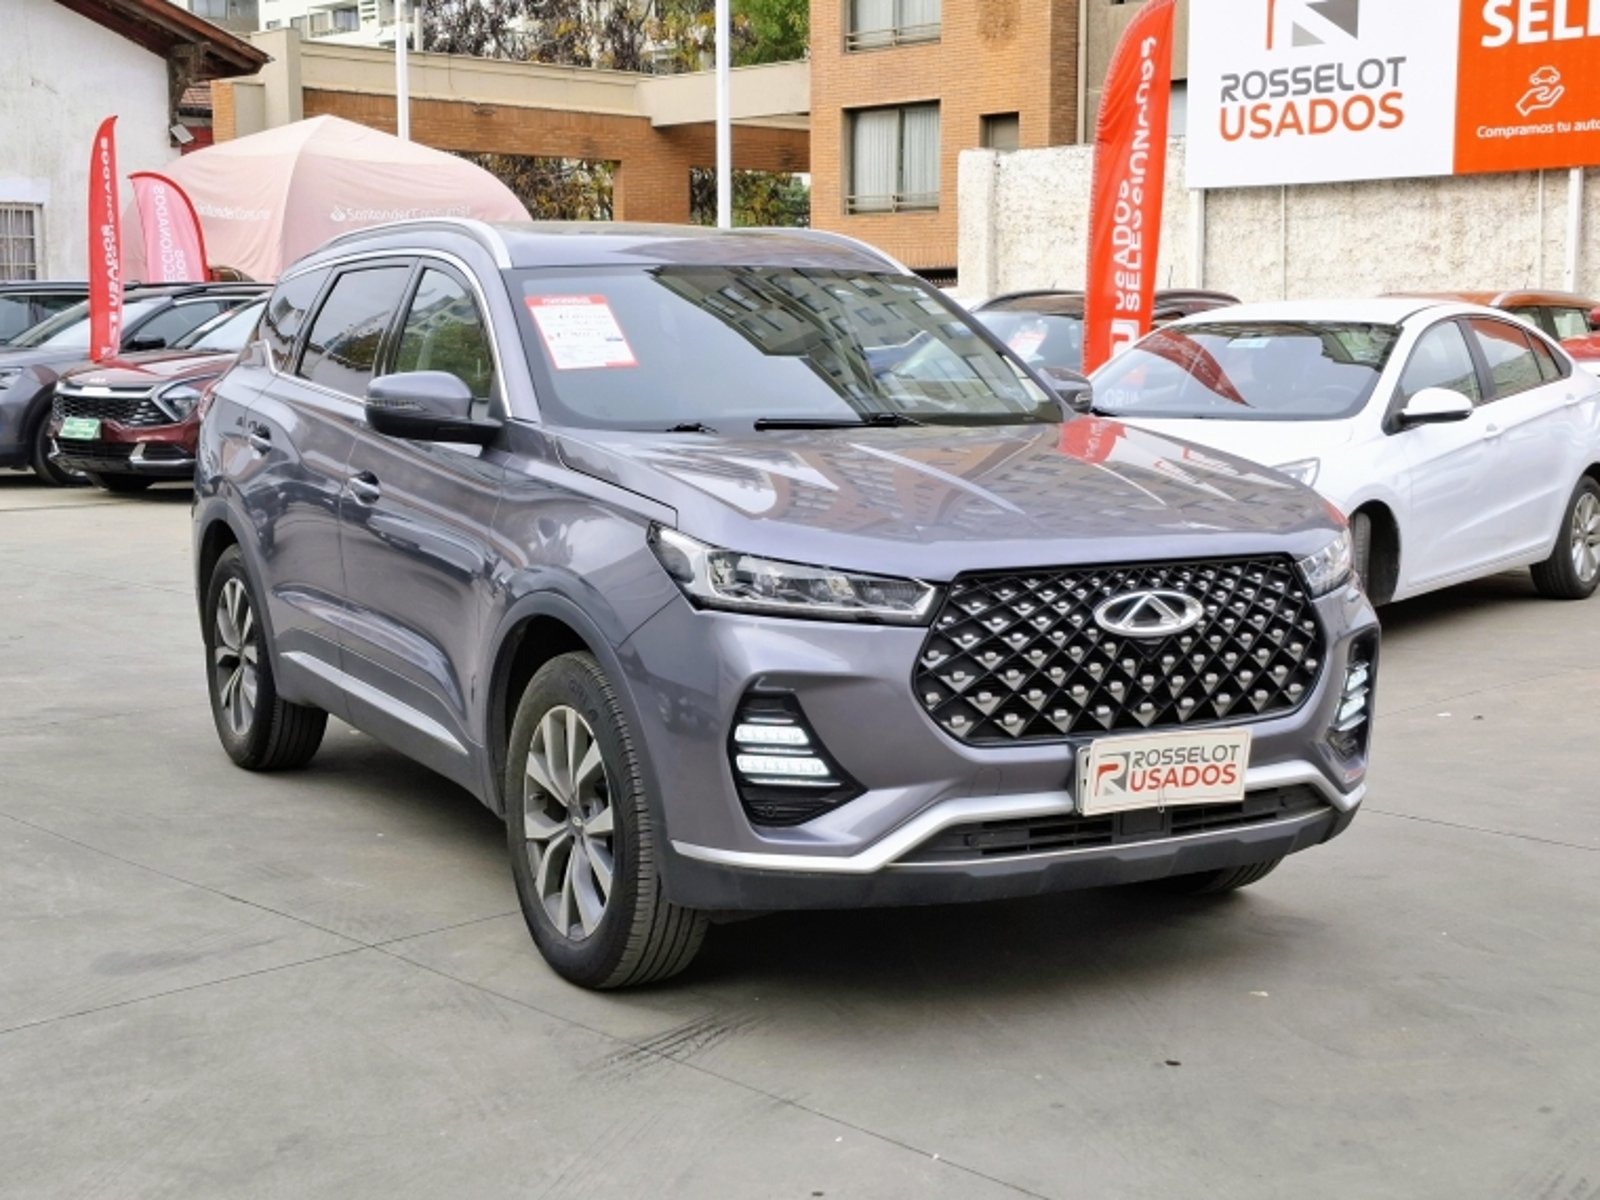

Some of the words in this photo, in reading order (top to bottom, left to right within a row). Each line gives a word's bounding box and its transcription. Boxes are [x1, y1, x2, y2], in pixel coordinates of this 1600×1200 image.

[1220, 57, 1407, 103] ROSSELOT
[1220, 92, 1405, 142] USADOS
[1477, 124, 1554, 139] Compramos
[1557, 121, 1571, 132] tu
[1131, 745, 1239, 769] ROSSELOT
[1130, 764, 1236, 791] USADOS
